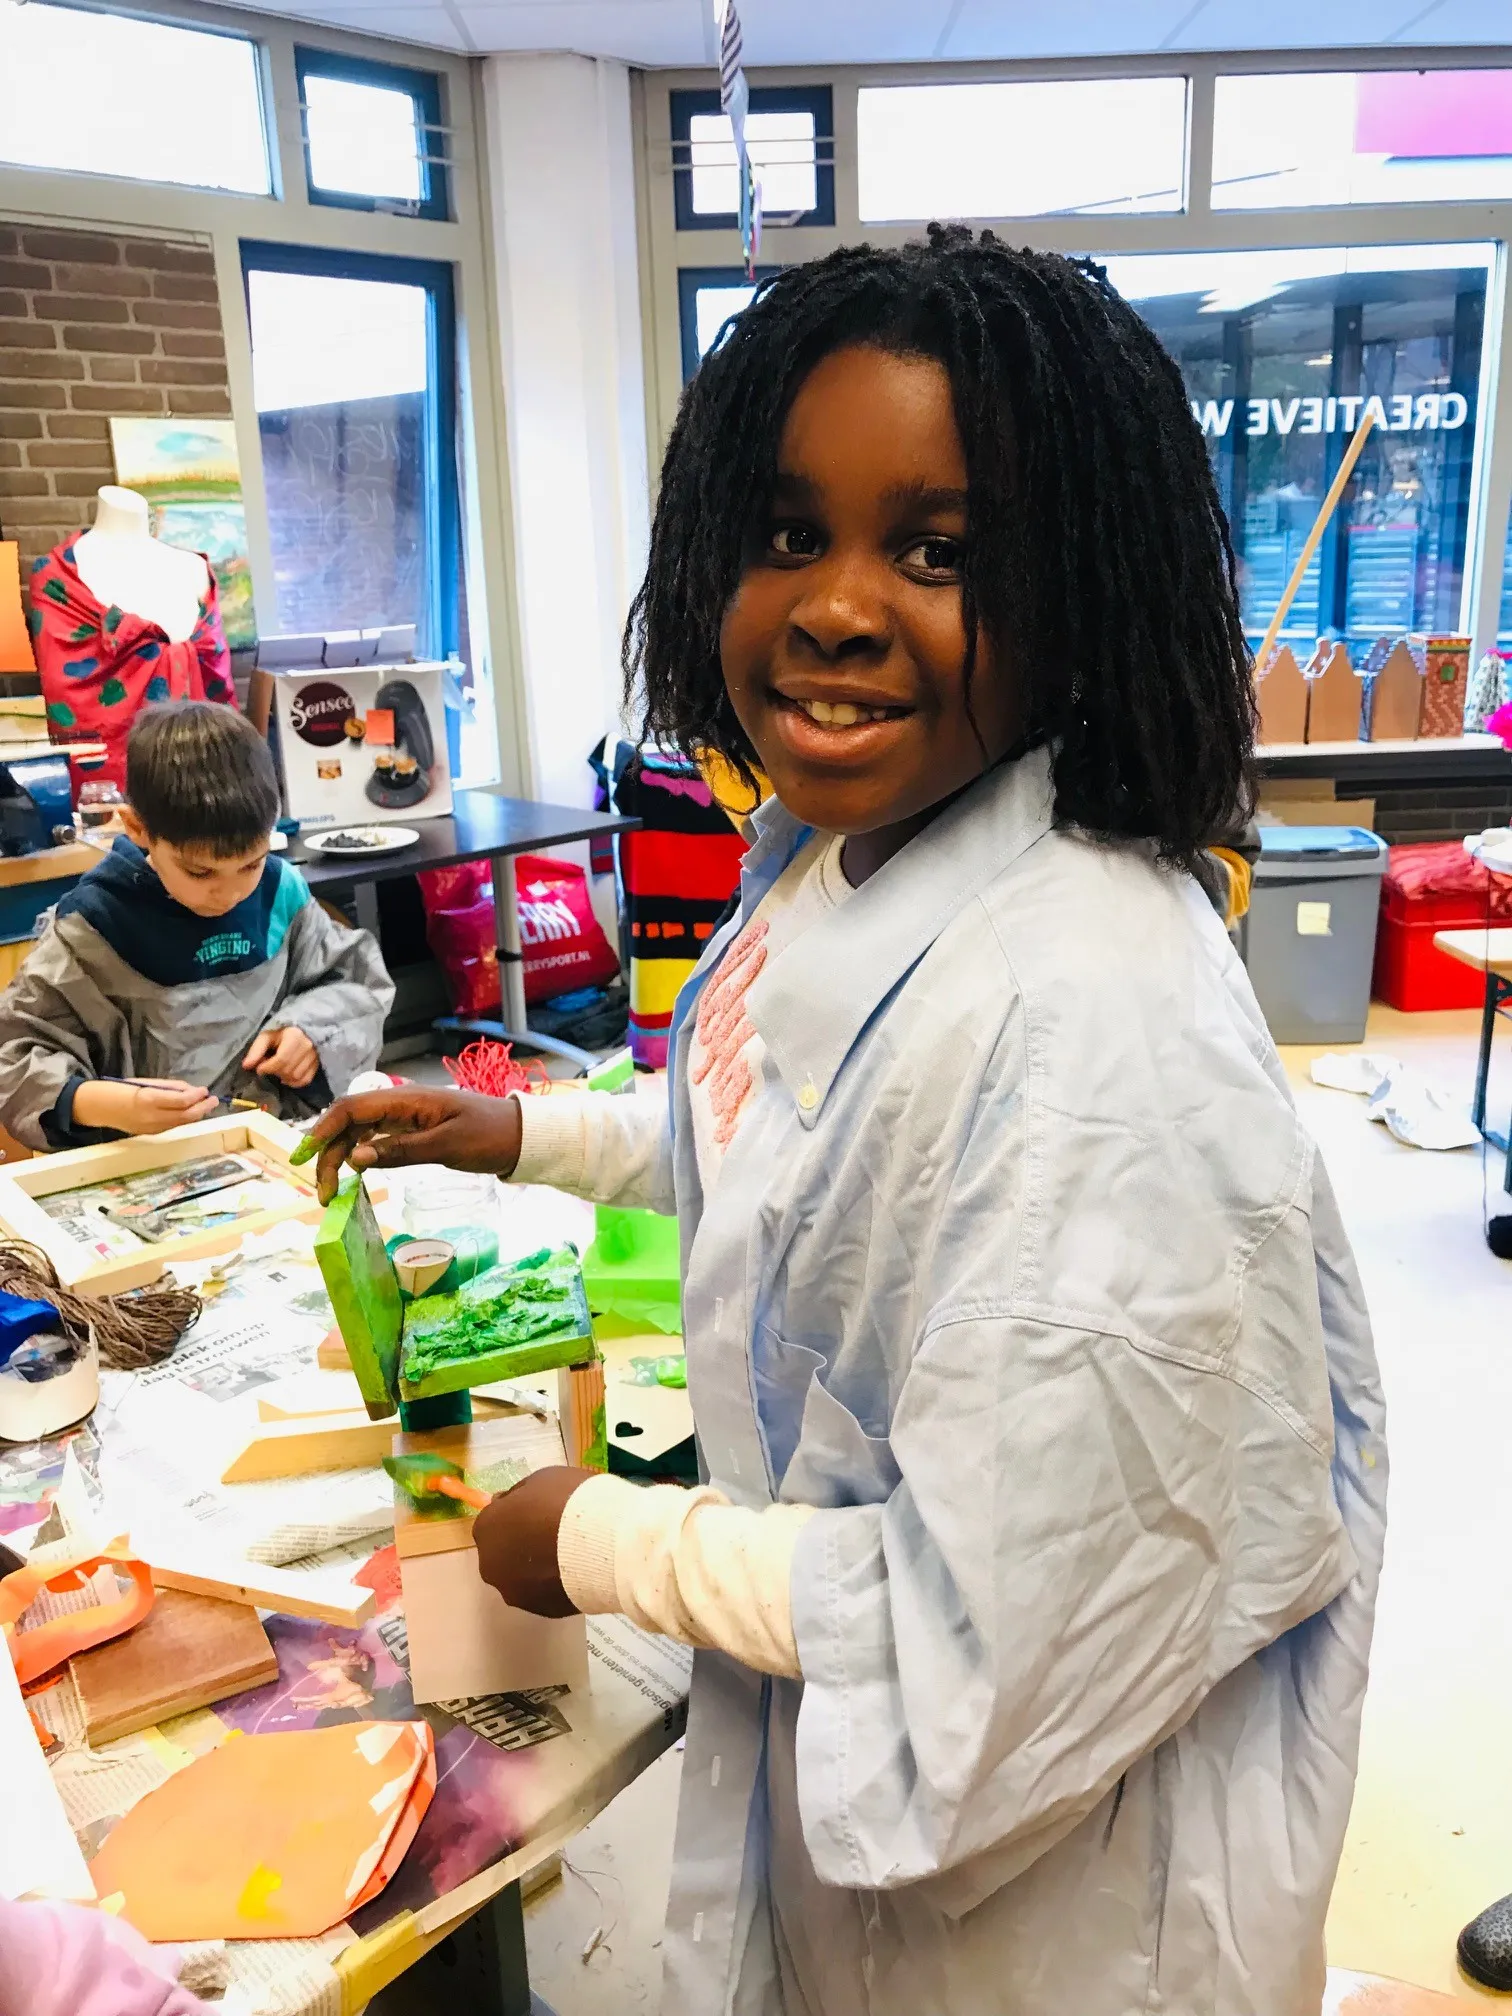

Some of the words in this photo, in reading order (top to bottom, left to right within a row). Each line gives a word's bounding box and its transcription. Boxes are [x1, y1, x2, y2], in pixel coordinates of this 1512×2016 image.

[517, 898, 582, 945] ERRY
[521, 950, 592, 974] ERRYSPORT.NL
[602, 1655, 645, 1688] genieten
